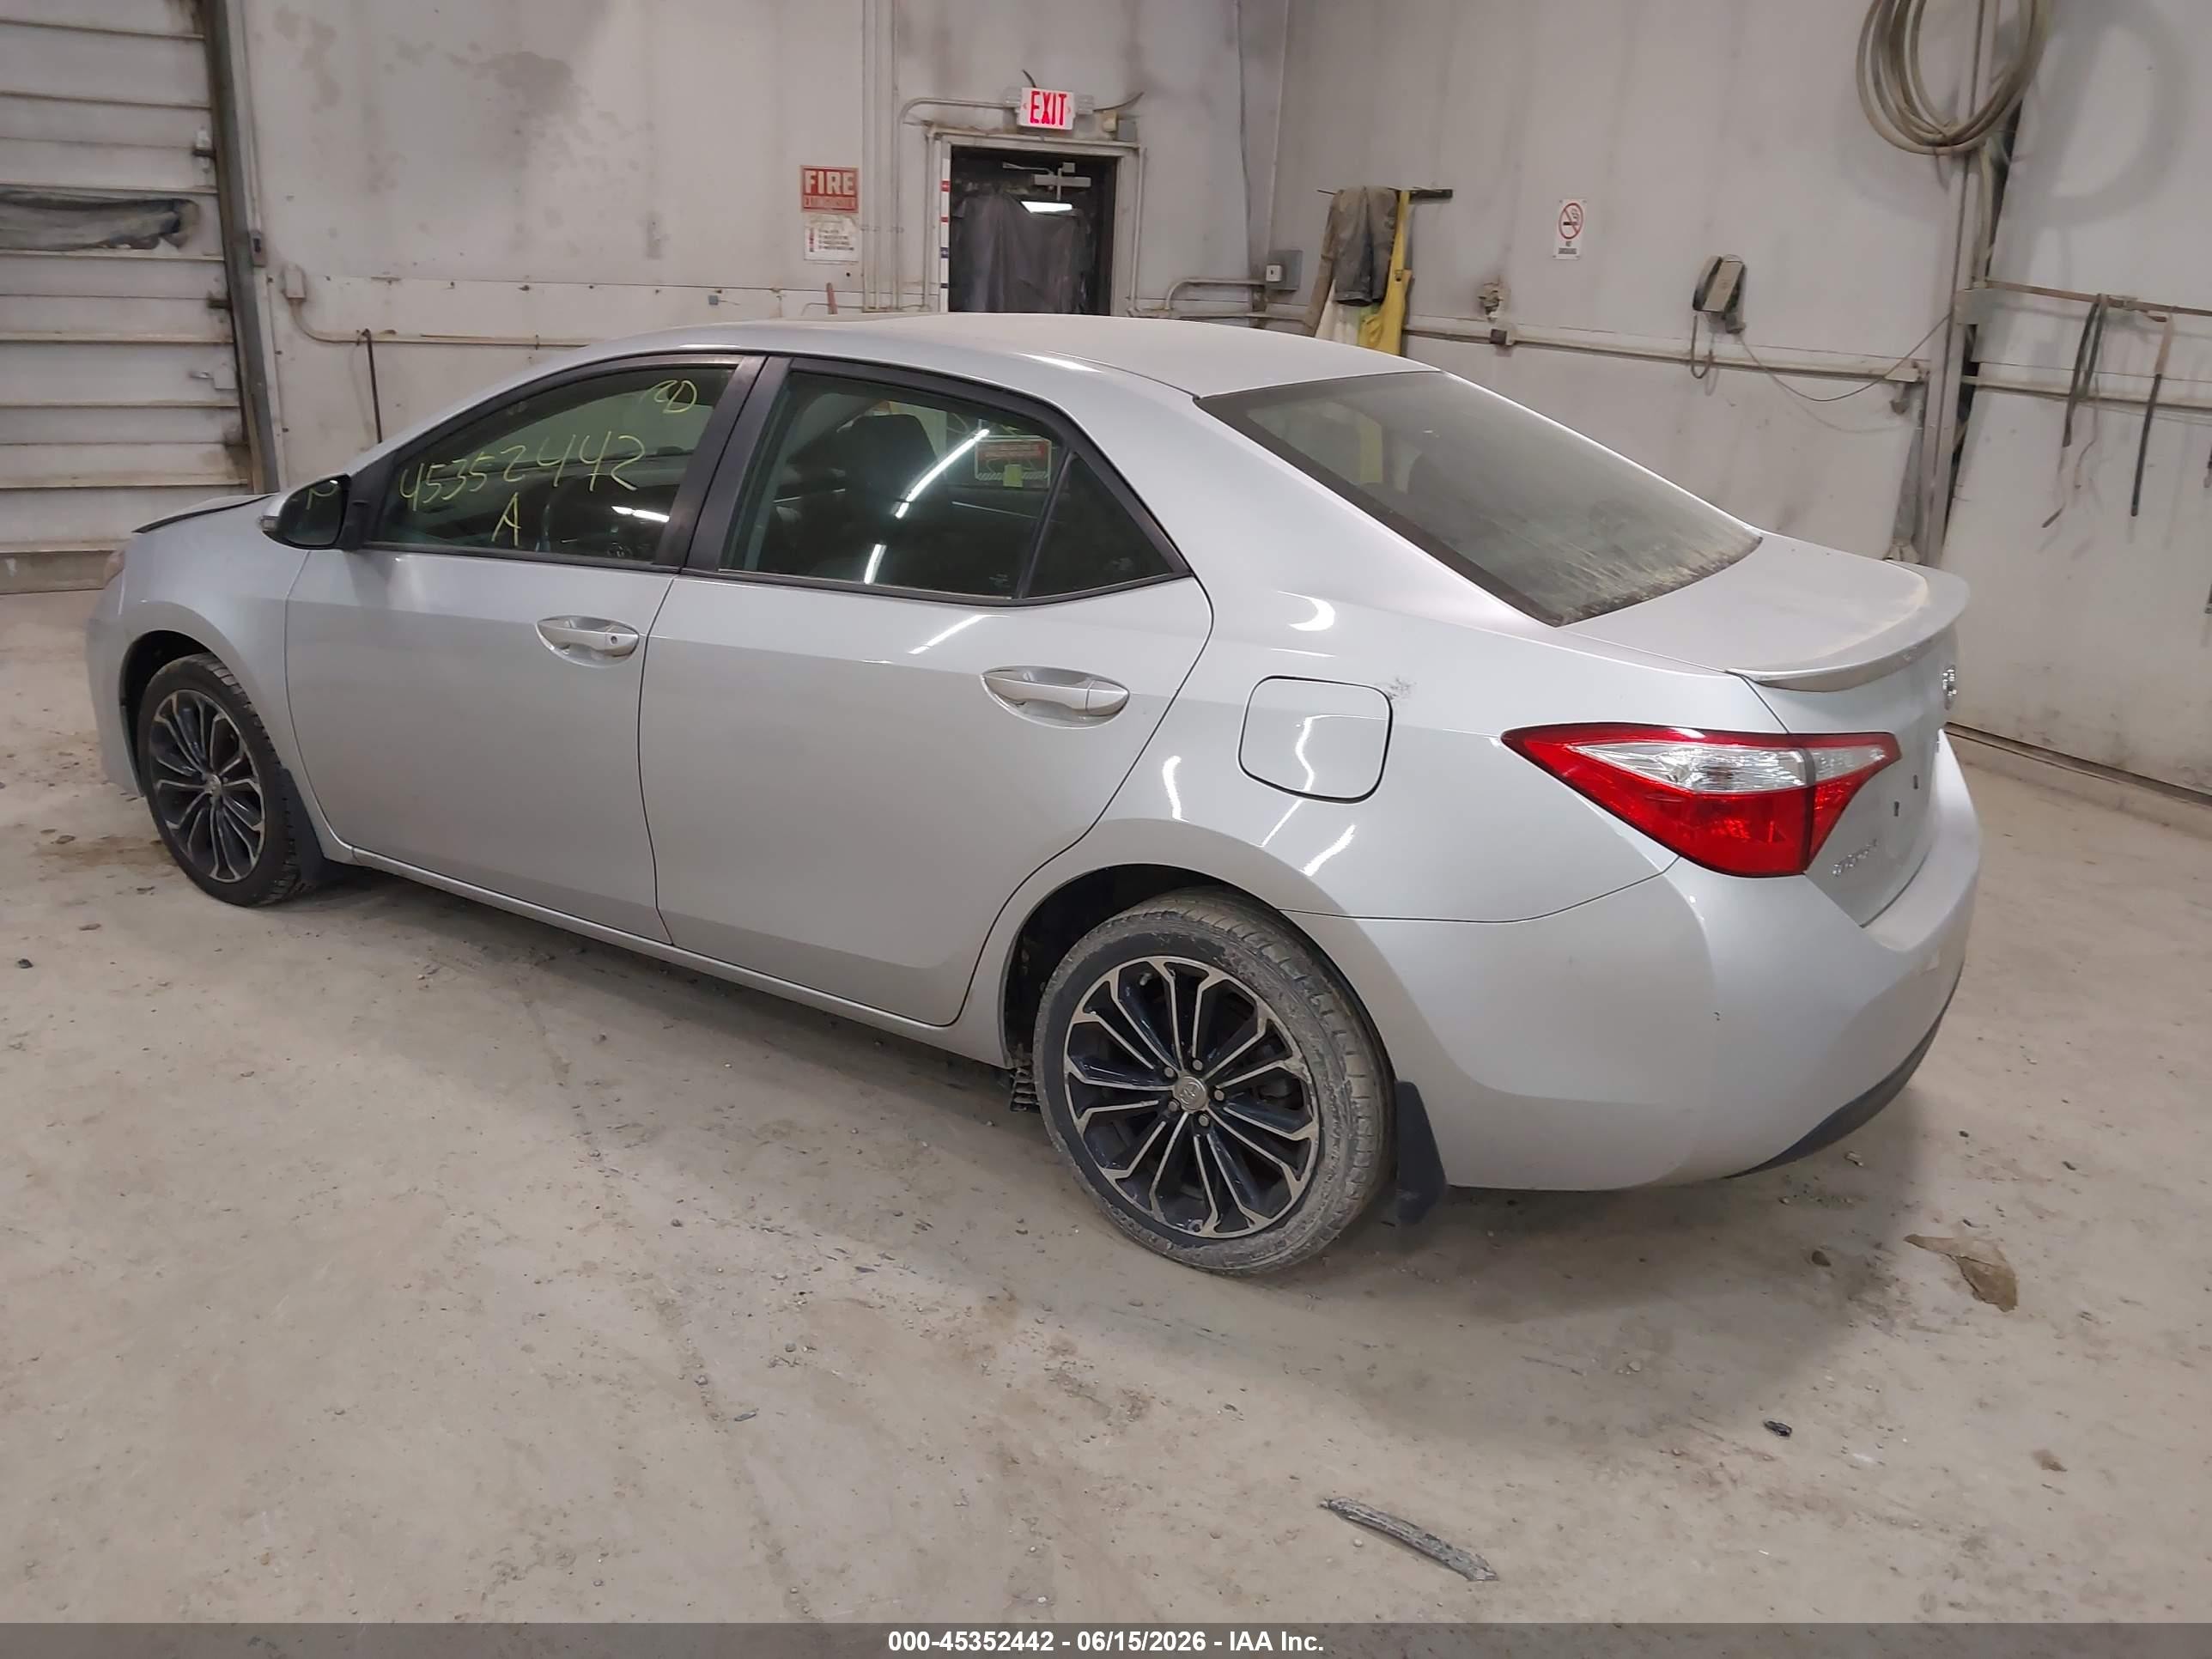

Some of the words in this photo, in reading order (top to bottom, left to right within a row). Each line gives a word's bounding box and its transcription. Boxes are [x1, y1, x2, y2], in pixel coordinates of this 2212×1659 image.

[1030, 90, 1067, 125] EXIT
[805, 170, 856, 196] FIRE
[399, 430, 647, 512] 45352442
[490, 491, 522, 547] A
